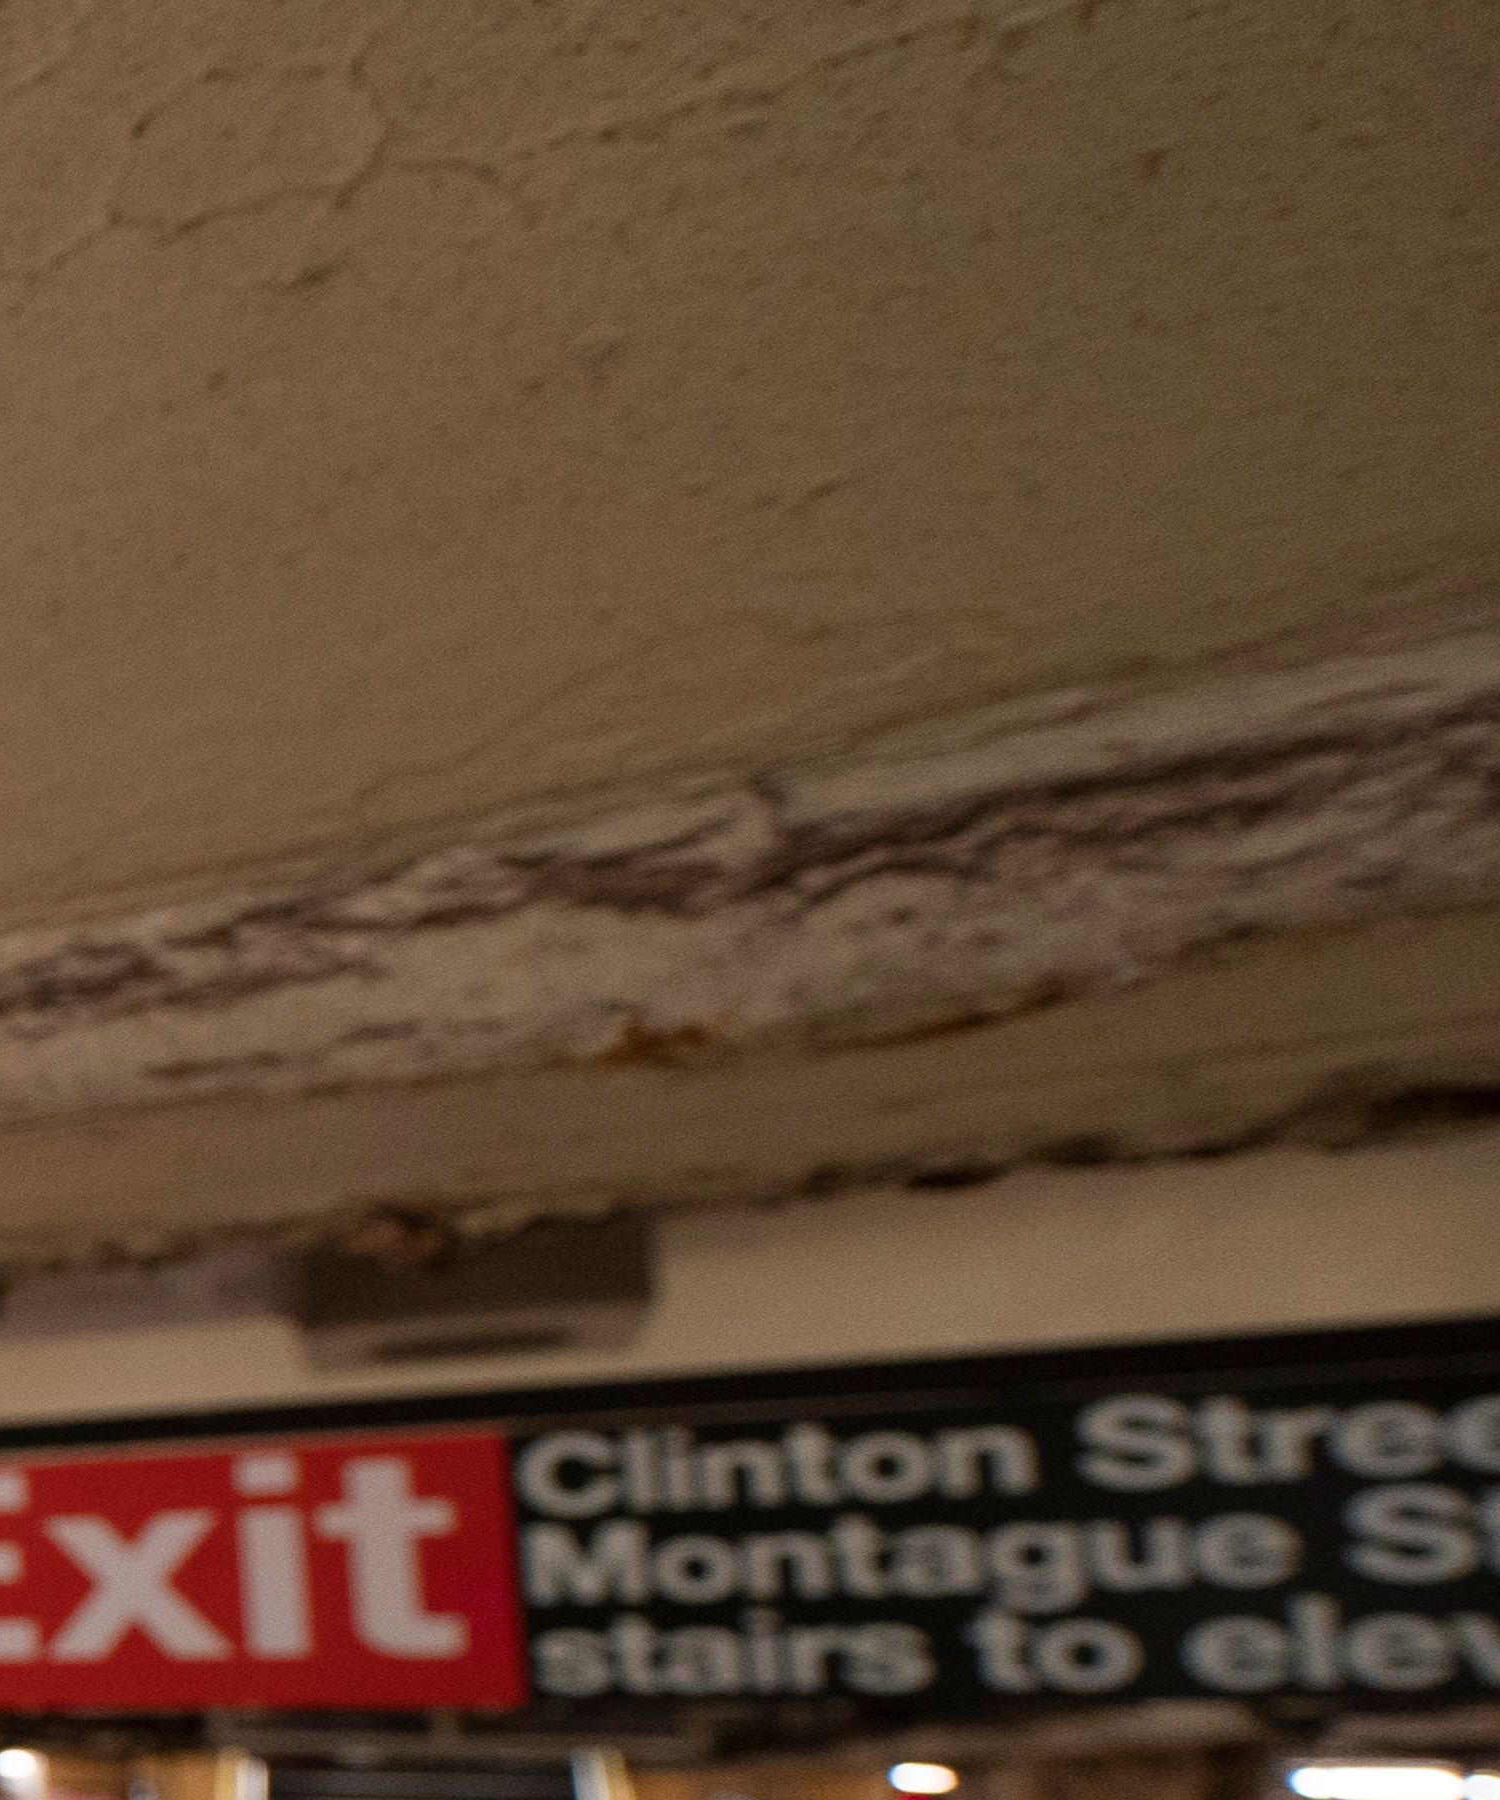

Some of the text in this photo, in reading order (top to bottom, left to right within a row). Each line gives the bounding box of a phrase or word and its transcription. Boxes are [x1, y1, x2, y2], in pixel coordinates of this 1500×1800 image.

[514, 1421, 1042, 1520] Clinton
[520, 1509, 1303, 1616] Montague
[528, 1606, 940, 1696] stairs
[964, 1603, 1146, 1695] to
